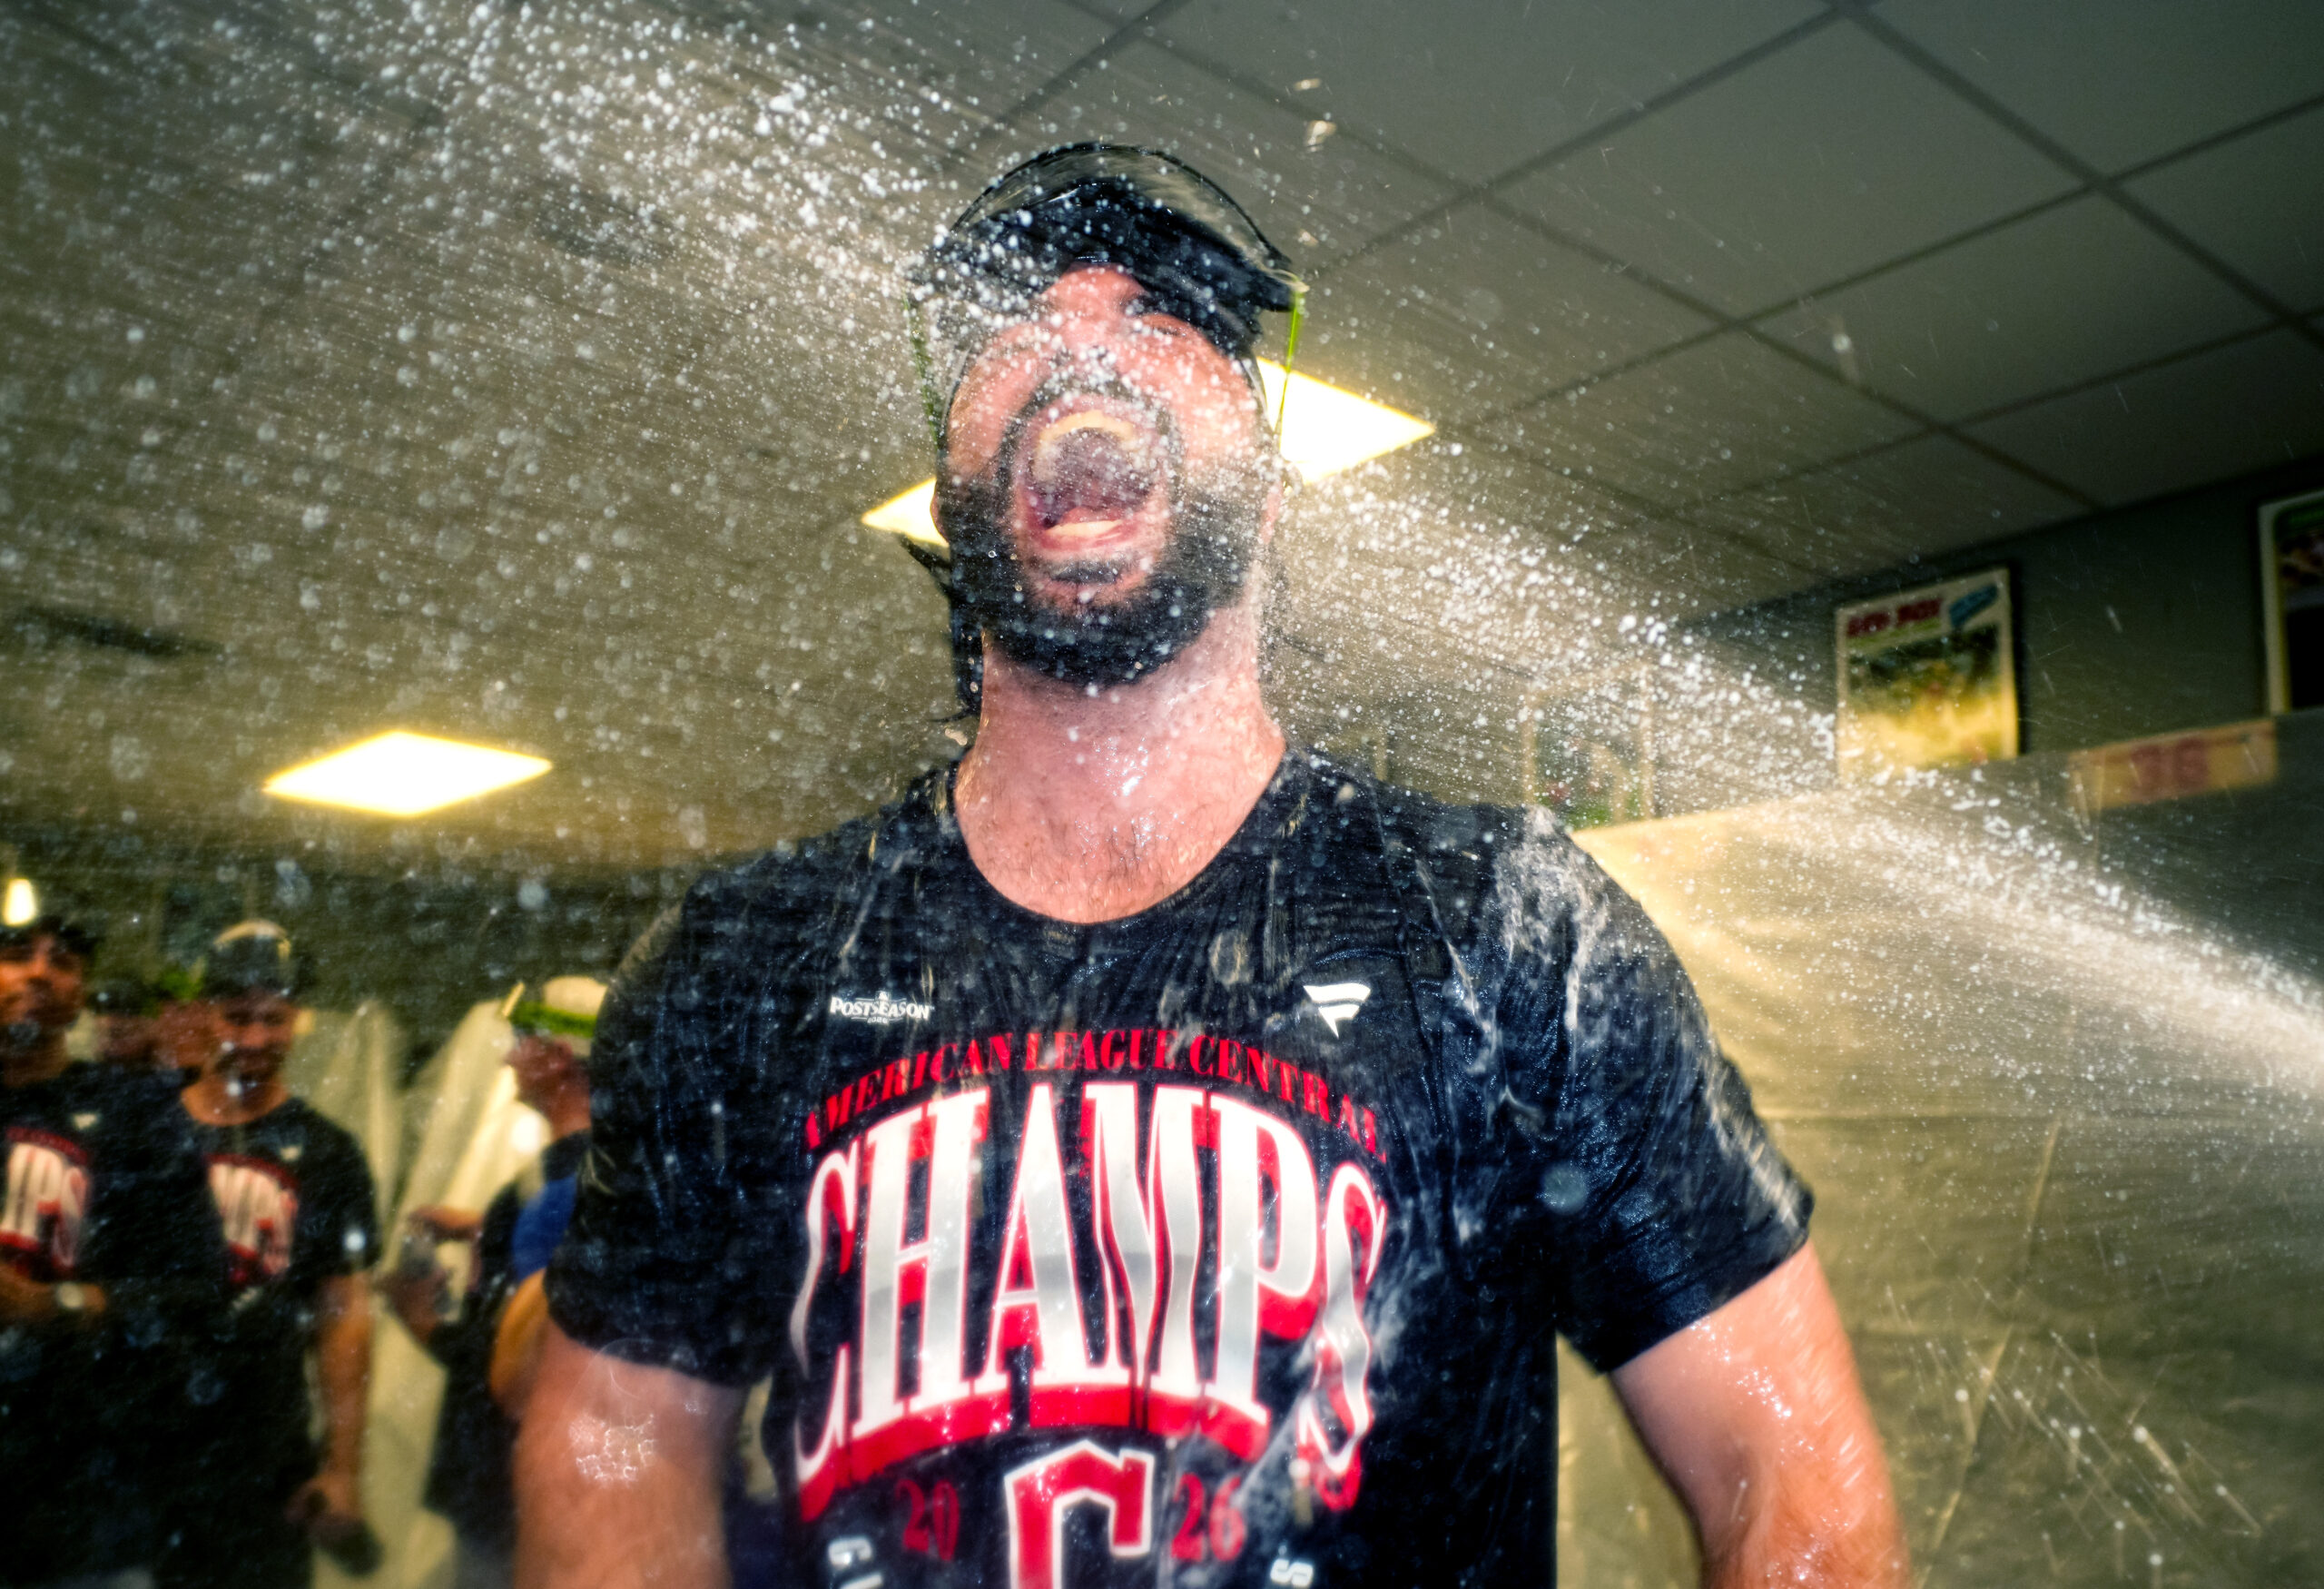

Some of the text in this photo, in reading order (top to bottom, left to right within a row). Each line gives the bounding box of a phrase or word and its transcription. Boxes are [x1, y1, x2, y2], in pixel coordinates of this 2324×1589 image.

[830, 996, 931, 1019] POSTSEASON
[804, 1029, 1388, 1165] AMERICAN LEAGUE CENTRAL
[790, 1081, 1389, 1511] CHAMPS
